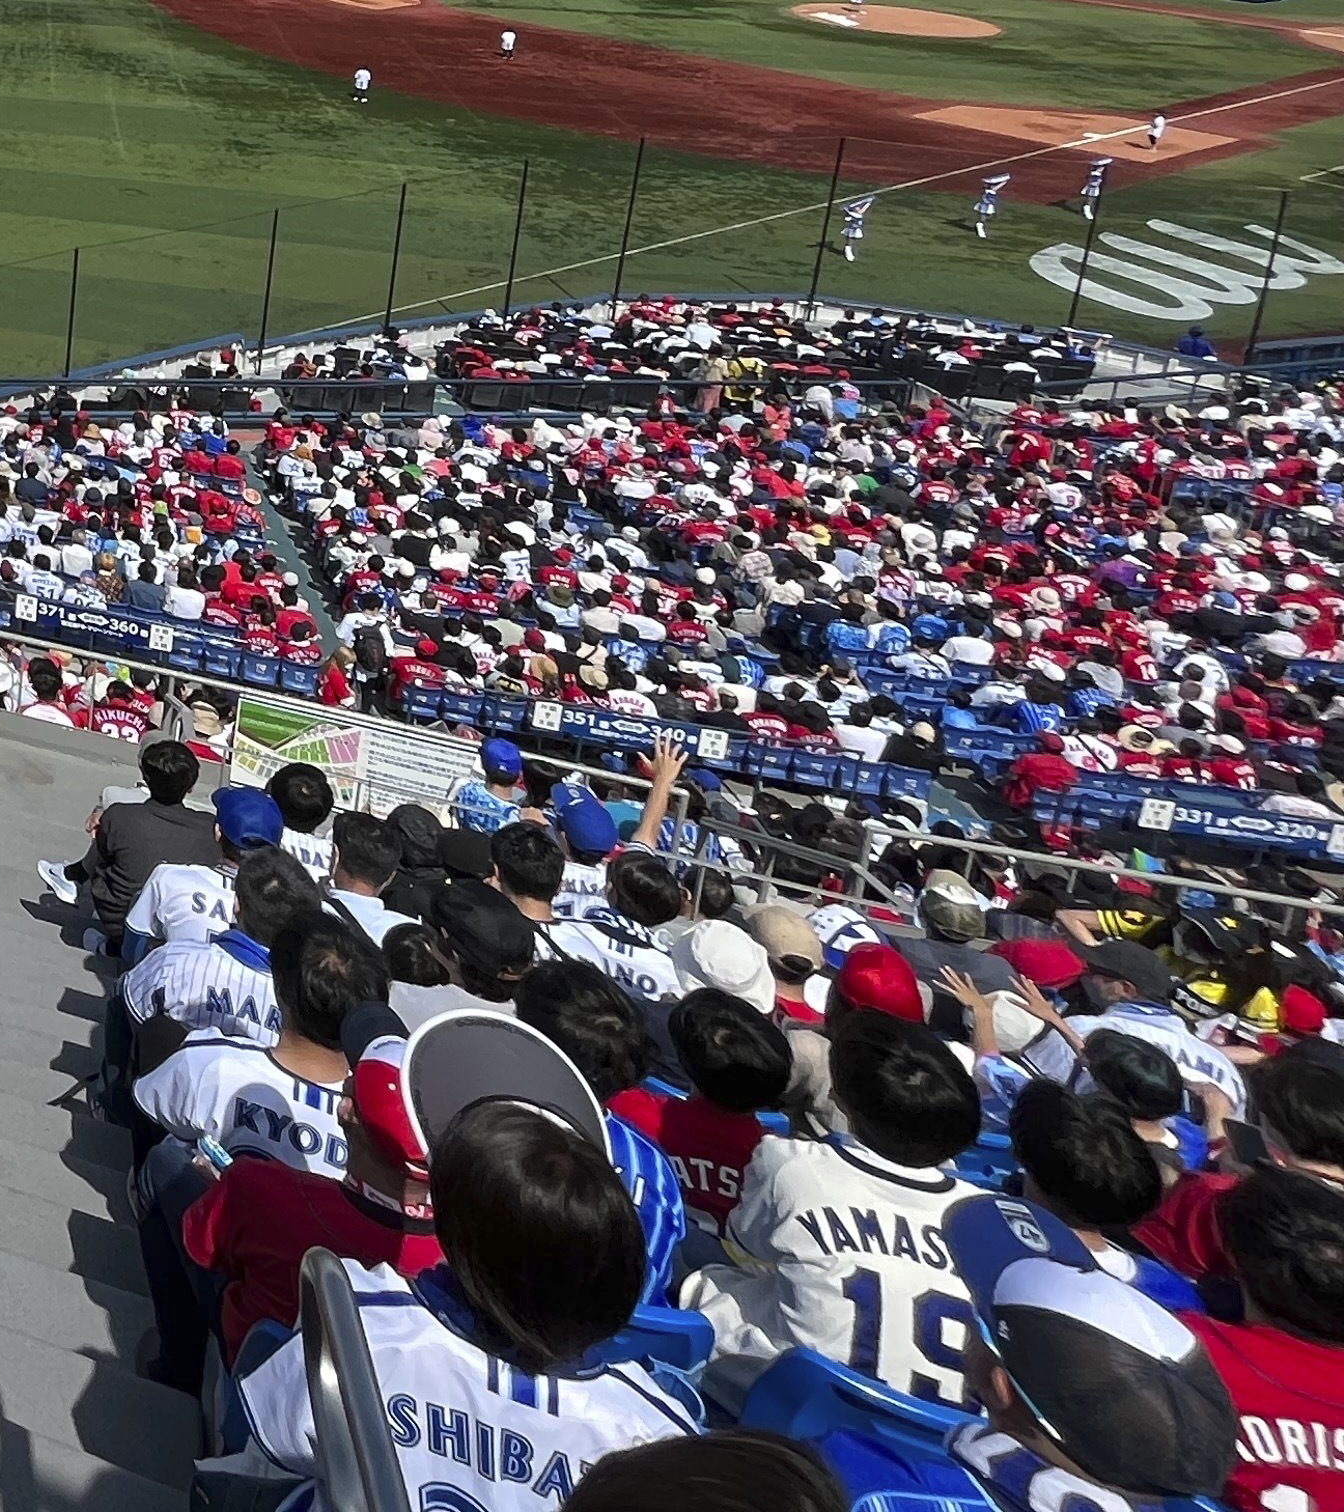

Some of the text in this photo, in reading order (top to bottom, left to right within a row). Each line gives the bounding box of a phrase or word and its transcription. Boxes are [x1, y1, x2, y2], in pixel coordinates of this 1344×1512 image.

[93, 708, 146, 732] KIKUCHI
[796, 1203, 958, 1278] YAMAS
[387, 1393, 596, 1504] SHIBA
